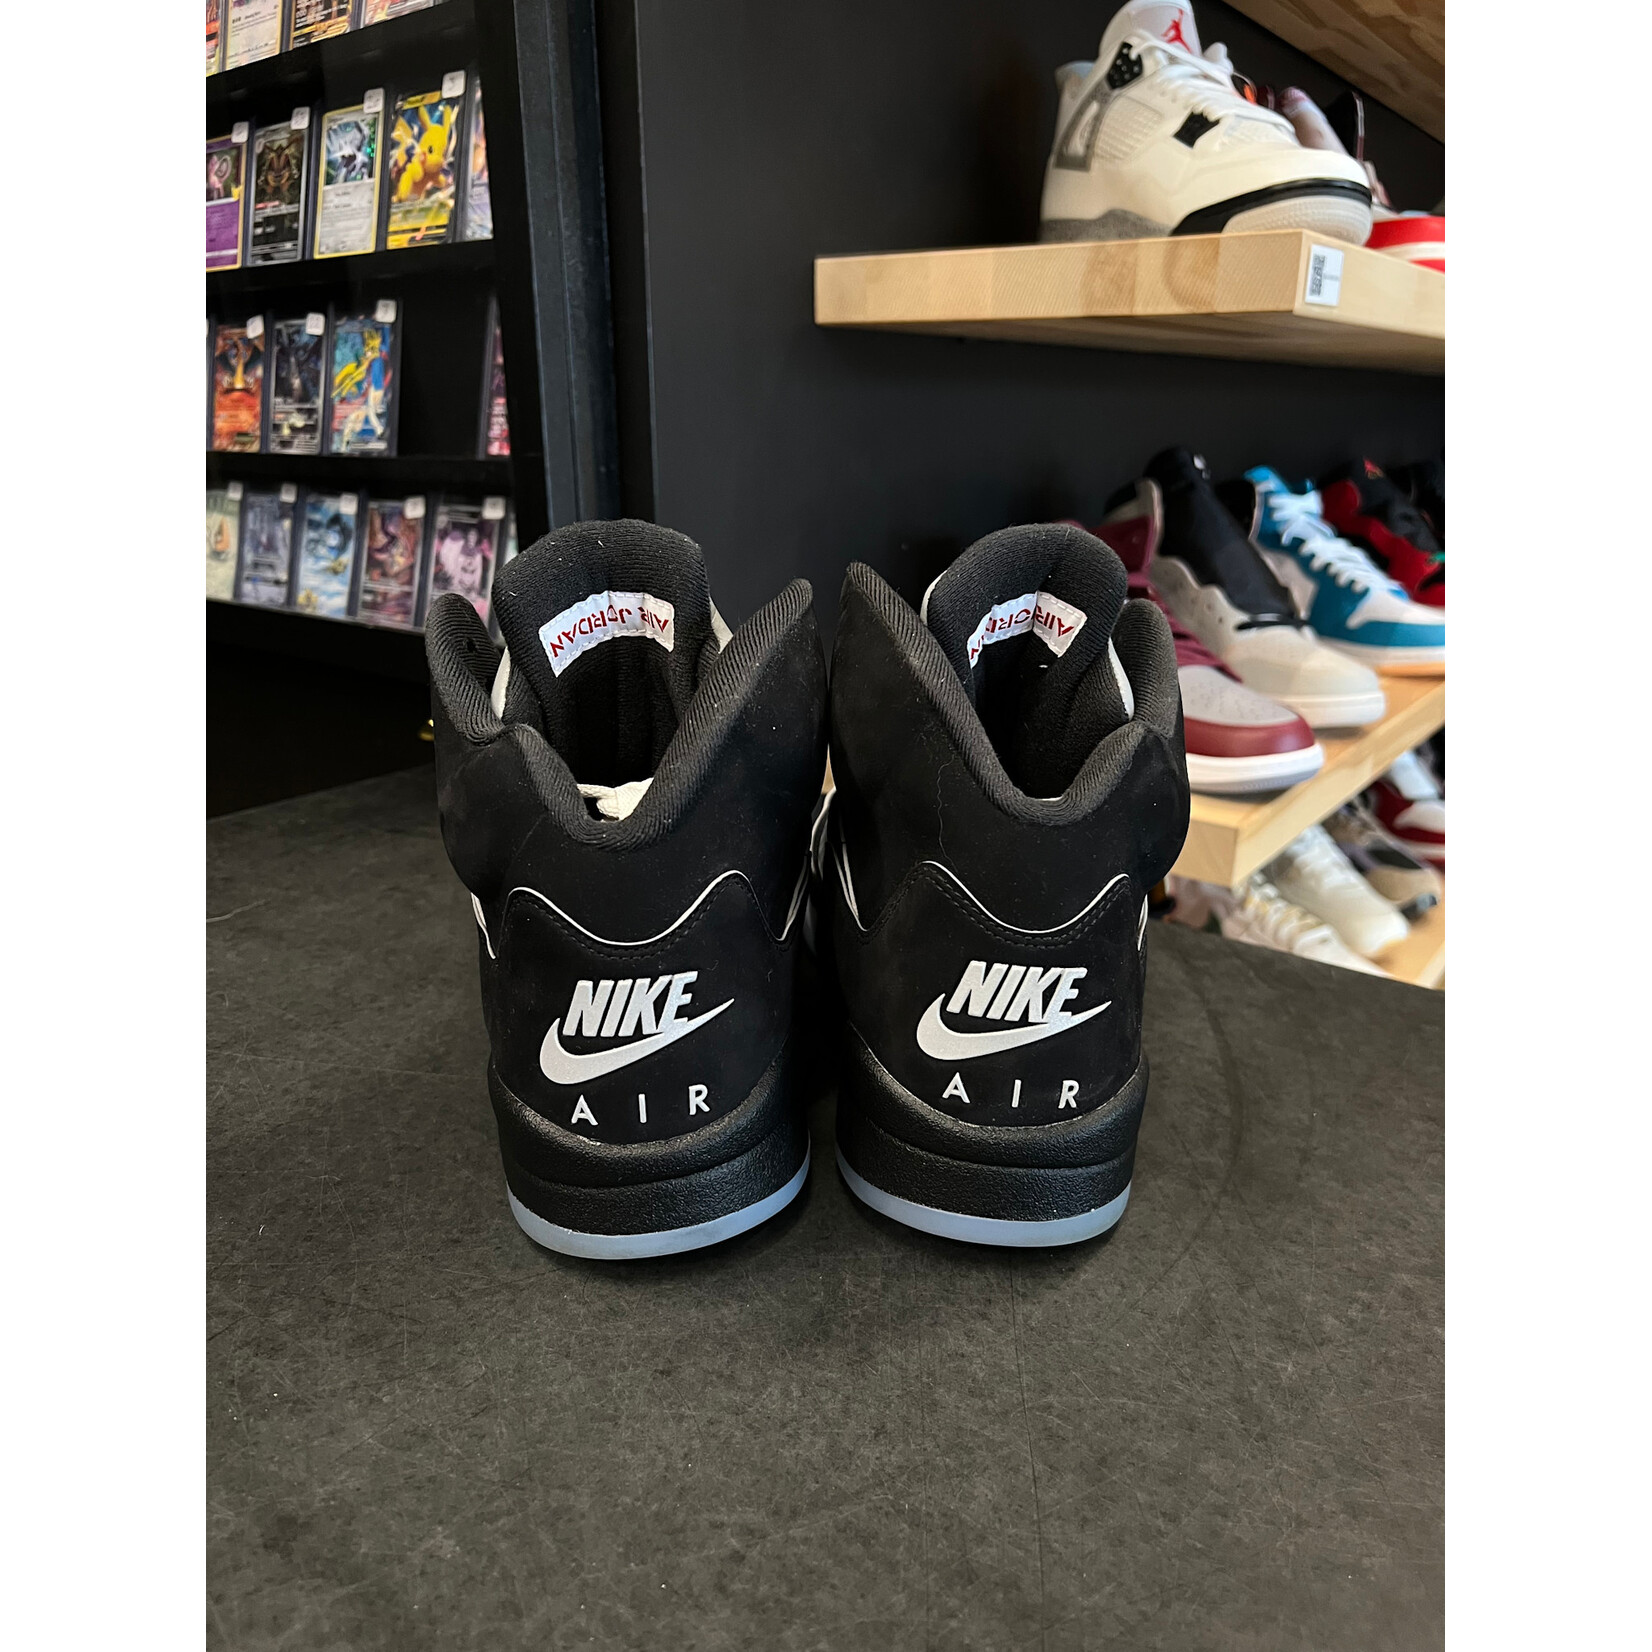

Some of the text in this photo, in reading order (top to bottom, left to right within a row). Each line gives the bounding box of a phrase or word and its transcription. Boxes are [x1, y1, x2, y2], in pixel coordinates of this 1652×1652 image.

[550, 604, 669, 657] AIR JORDAN
[1034, 604, 1074, 637] AIR
[562, 971, 699, 1037] NIKE
[946, 960, 1087, 1023] NIKE
[571, 1084, 710, 1126] AIR
[942, 1072, 1079, 1109] AIR
